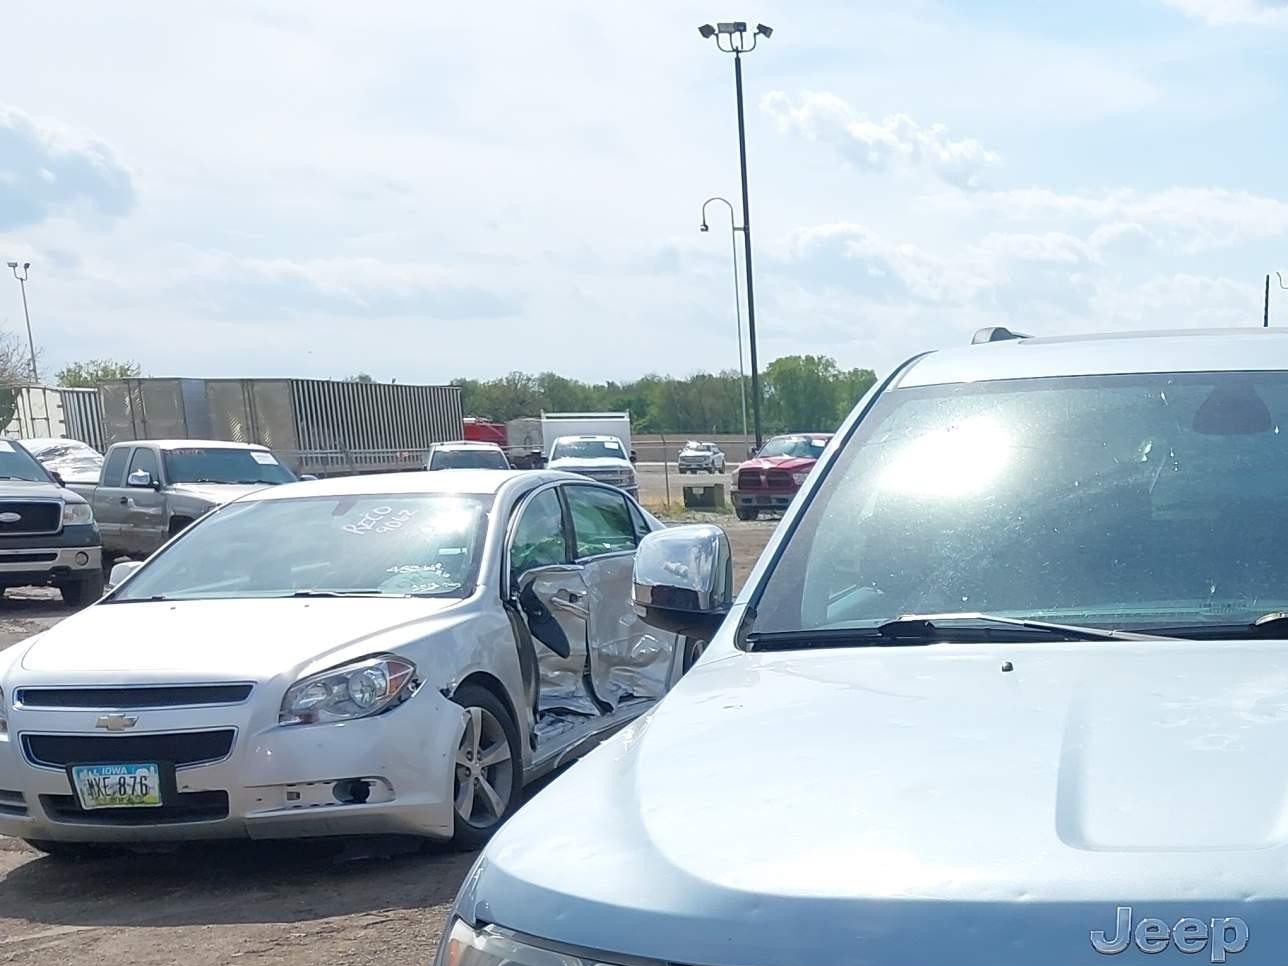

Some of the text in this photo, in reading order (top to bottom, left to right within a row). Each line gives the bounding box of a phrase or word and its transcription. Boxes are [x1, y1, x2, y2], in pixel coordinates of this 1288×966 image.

[102, 766, 128, 775] IOWA
[118, 775, 148, 797] 876
[1090, 906, 1249, 963] Jeep
